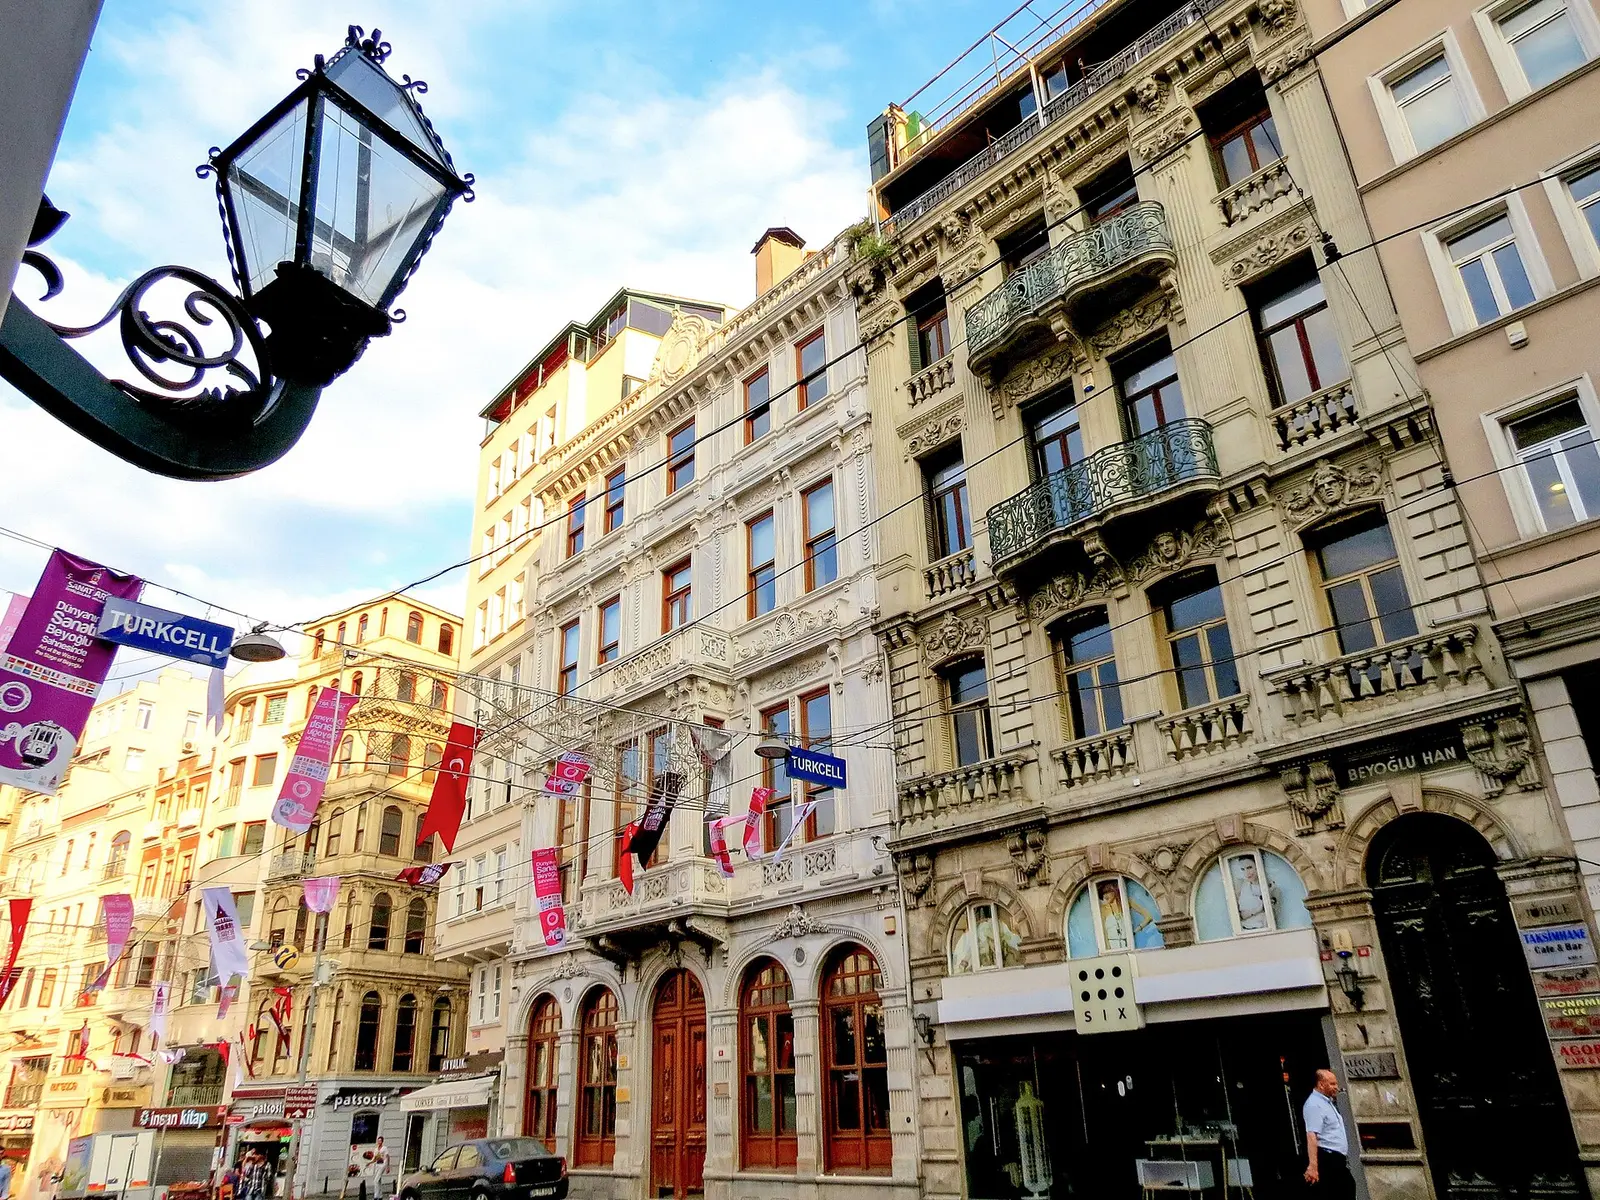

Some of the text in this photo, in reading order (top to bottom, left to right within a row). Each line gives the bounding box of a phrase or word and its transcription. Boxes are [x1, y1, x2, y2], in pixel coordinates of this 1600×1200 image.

[68, 581, 94, 595] SANAT
[94, 591, 108, 601] AR
[45, 623, 94, 647] Beyoğlu
[110, 610, 223, 655] TURKCELL
[41, 635, 88, 657] Sahnesinde
[792, 756, 844, 780] TURKCELL
[1348, 746, 1457, 782] BEYOĞLU HAN
[1557, 944, 1564, 952] &
[1564, 942, 1583, 951] Bar
[1084, 1008, 1127, 1022] SIX
[334, 1092, 388, 1111] patsosis
[180, 1109, 207, 1129] kitap
